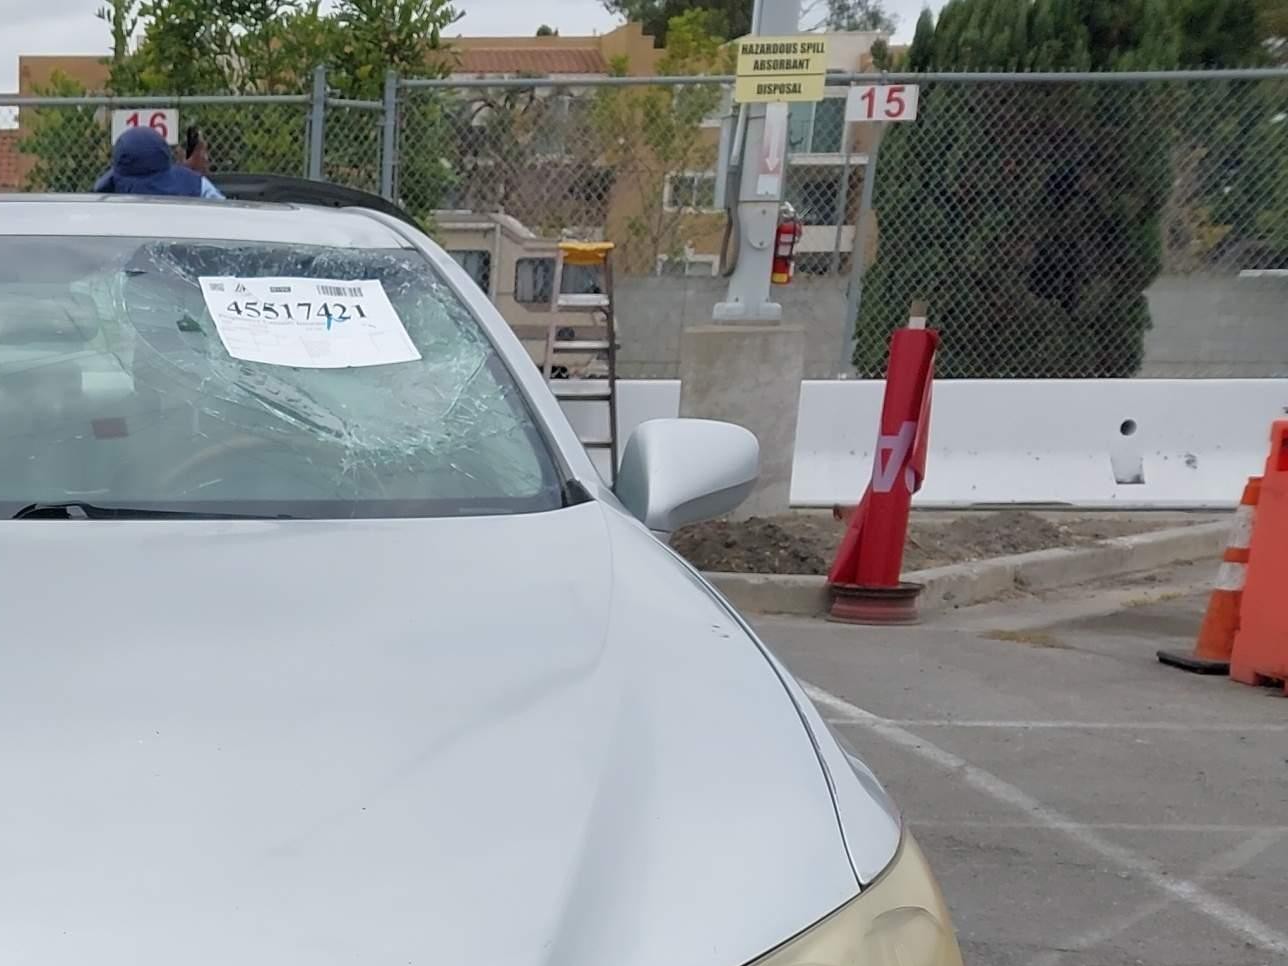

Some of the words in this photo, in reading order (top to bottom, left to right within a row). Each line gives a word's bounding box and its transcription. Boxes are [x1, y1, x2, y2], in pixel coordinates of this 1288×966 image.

[741, 42, 798, 55] HAZARDOUS
[800, 42, 825, 54] SPILL
[753, 58, 811, 71] ABSORBANT
[756, 83, 802, 95] DISPOSAL
[860, 86, 906, 119] 15
[227, 300, 368, 321] 45517421
